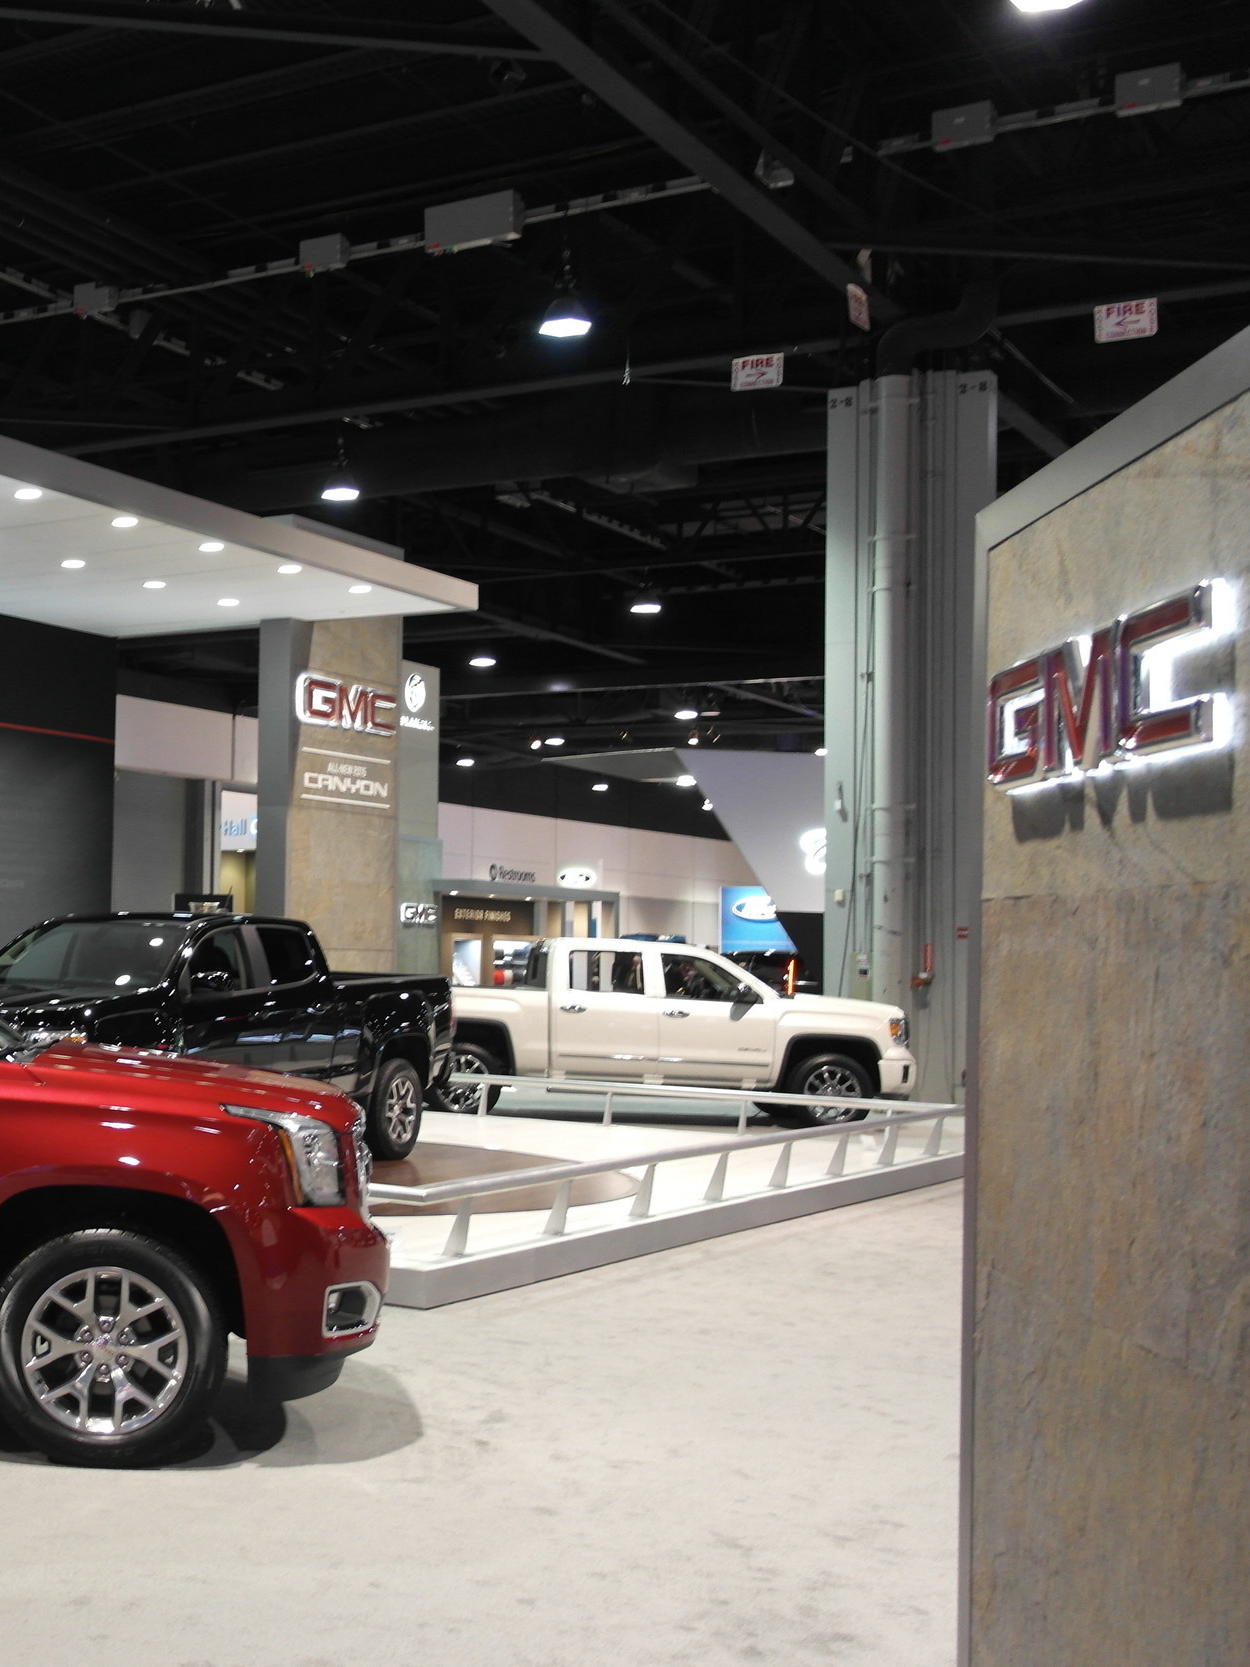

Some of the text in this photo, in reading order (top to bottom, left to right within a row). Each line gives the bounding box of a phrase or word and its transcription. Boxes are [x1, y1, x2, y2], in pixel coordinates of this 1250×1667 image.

[1106, 302, 1146, 318] FIRE
[741, 356, 775, 371] FIRE
[987, 577, 1214, 787] GMC
[299, 674, 397, 737] GMC
[303, 771, 388, 798] CANYON
[223, 818, 247, 836] Hall
[499, 866, 536, 882] Restrooms
